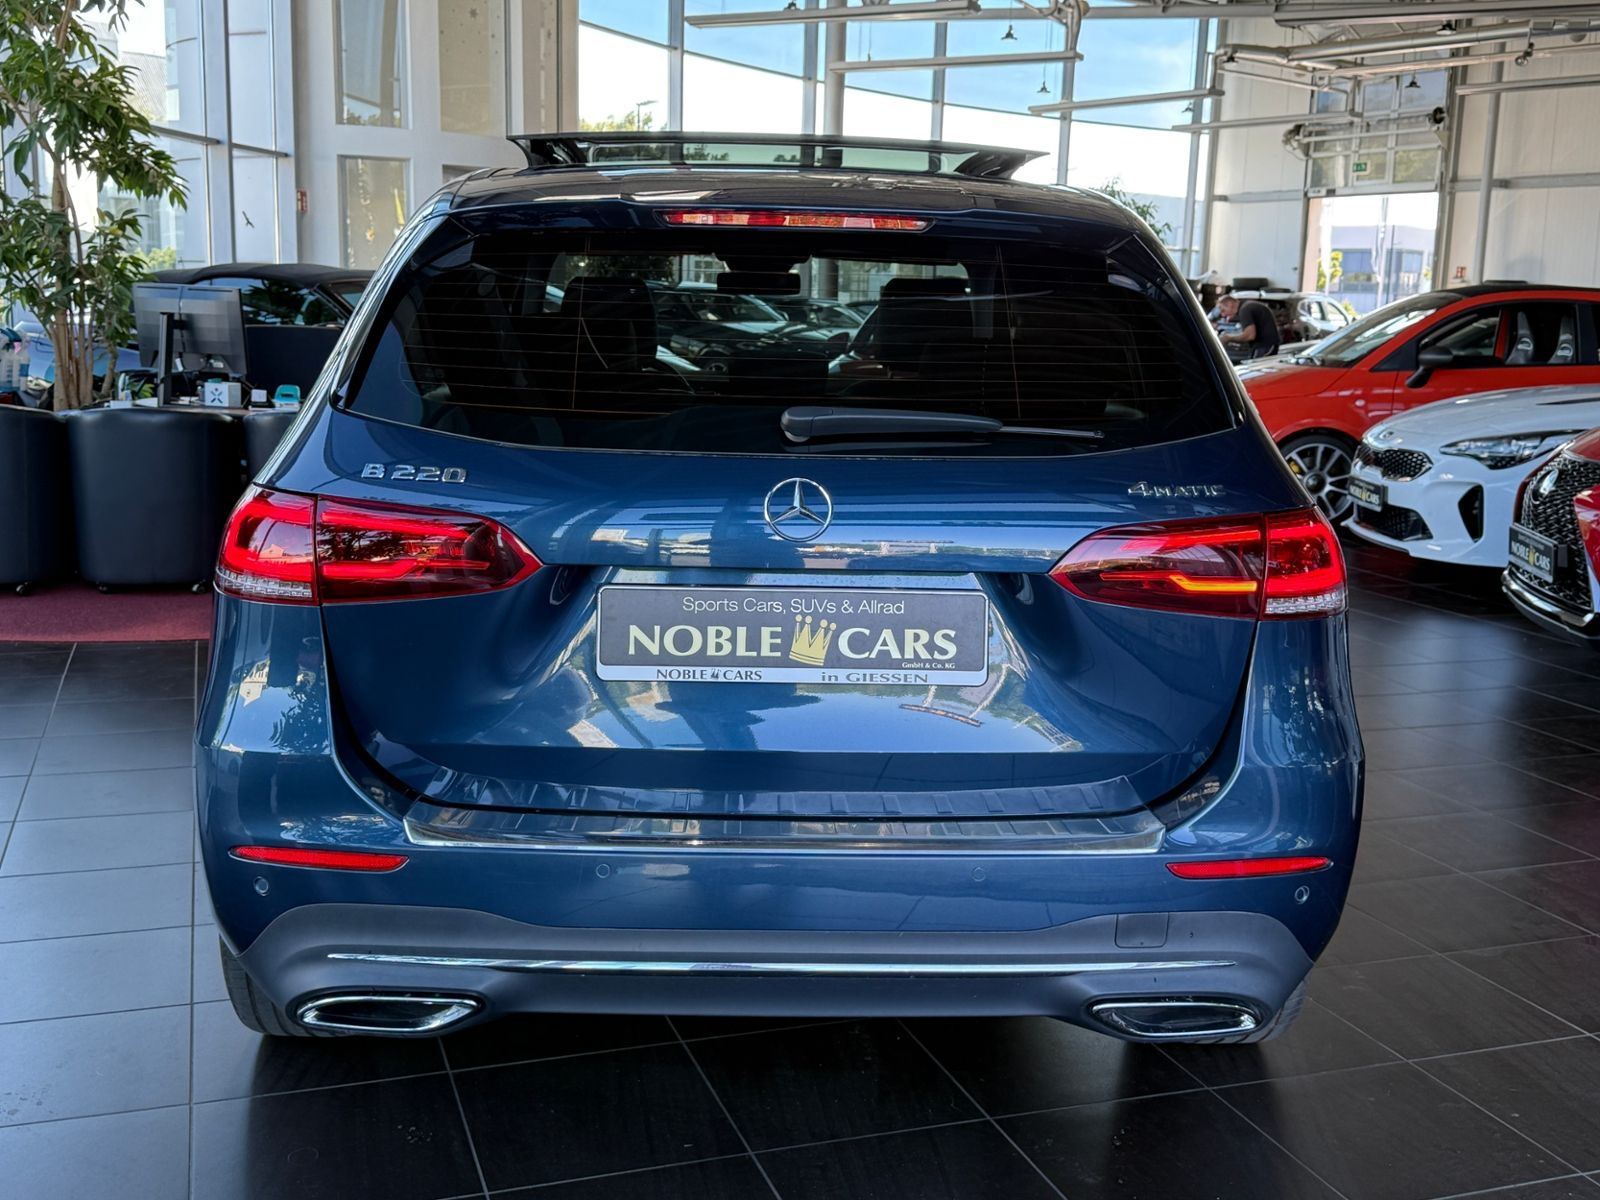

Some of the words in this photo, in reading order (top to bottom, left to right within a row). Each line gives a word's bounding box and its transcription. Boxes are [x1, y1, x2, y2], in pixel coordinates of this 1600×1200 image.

[361, 463, 386, 478] B
[391, 464, 467, 483] 220
[1127, 481, 1225, 497] 4MATIC
[682, 596, 739, 614] Sports
[743, 598, 786, 614] Cars,
[790, 598, 837, 613] SUVs
[841, 599, 854, 614] &
[858, 599, 905, 615] Allrad
[628, 624, 782, 657] NOBLE
[838, 627, 957, 660] CARS
[901, 661, 924, 669] GmbH
[656, 668, 707, 680] NOBLE
[722, 669, 763, 681] CARS
[822, 671, 839, 682] in
[847, 672, 929, 684] GIESSEN
